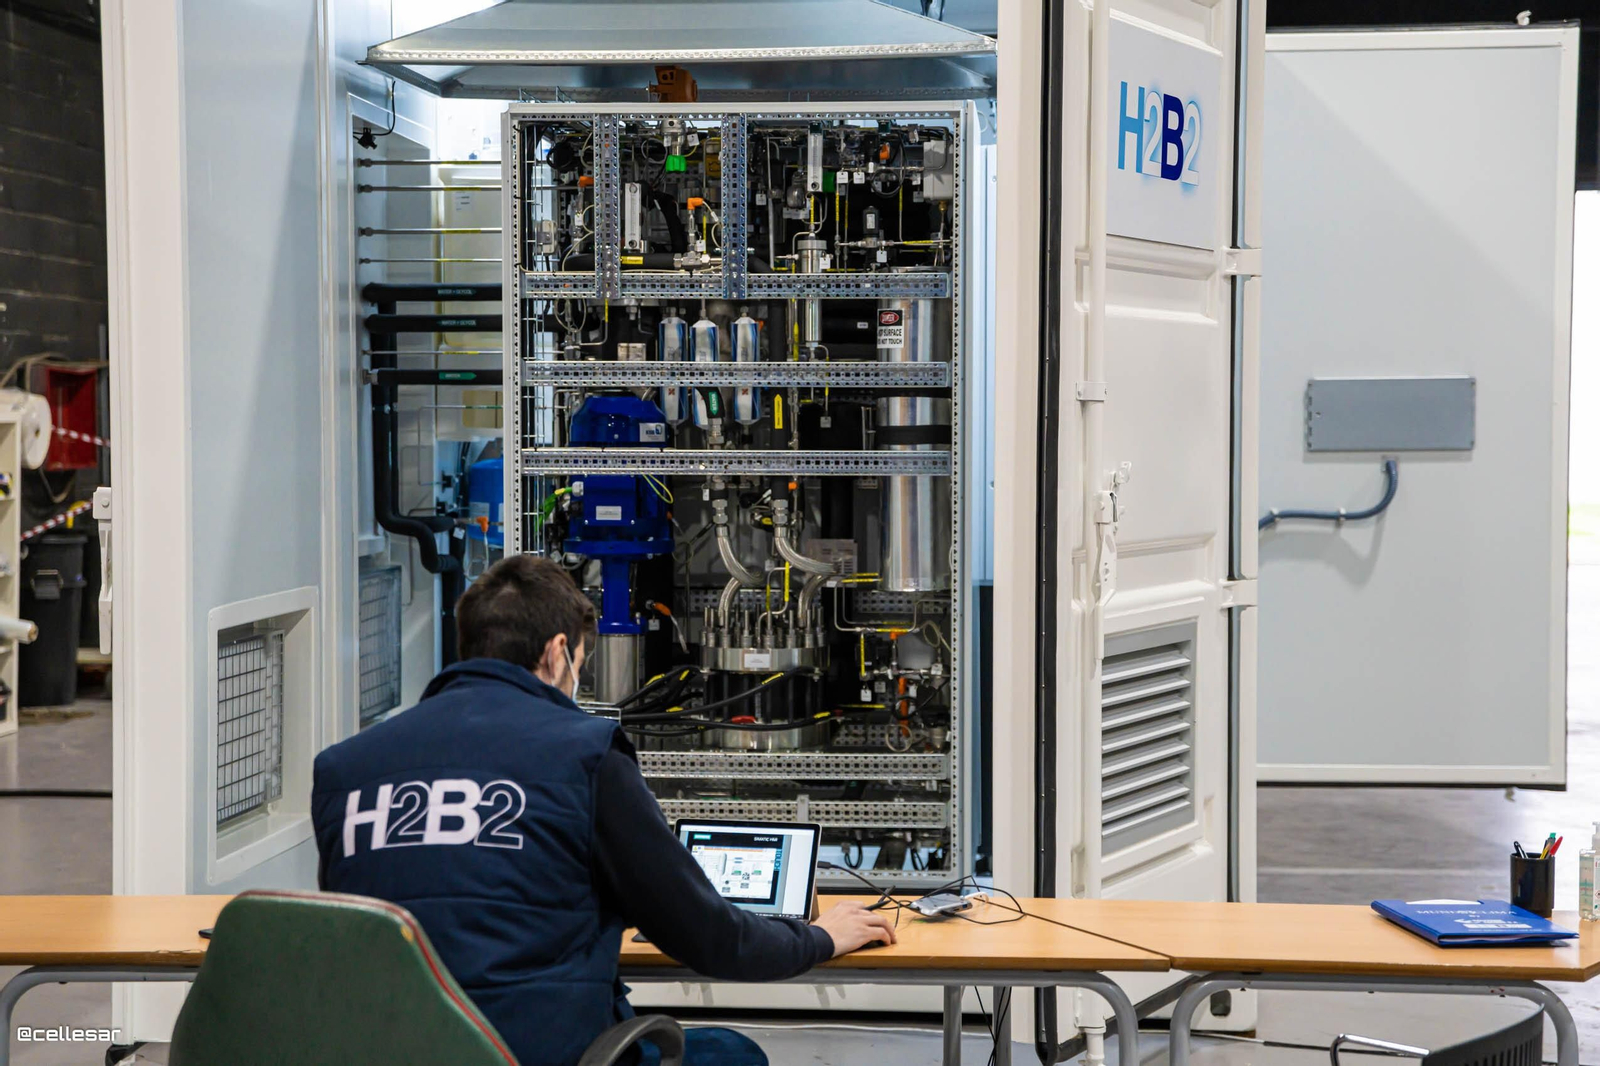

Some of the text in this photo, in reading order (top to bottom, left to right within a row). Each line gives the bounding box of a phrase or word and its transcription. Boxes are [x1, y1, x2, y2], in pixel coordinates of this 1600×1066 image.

[1118, 81, 1201, 186] H2B2
[884, 329, 902, 337] SURFACE
[343, 779, 527, 858] H2B2
